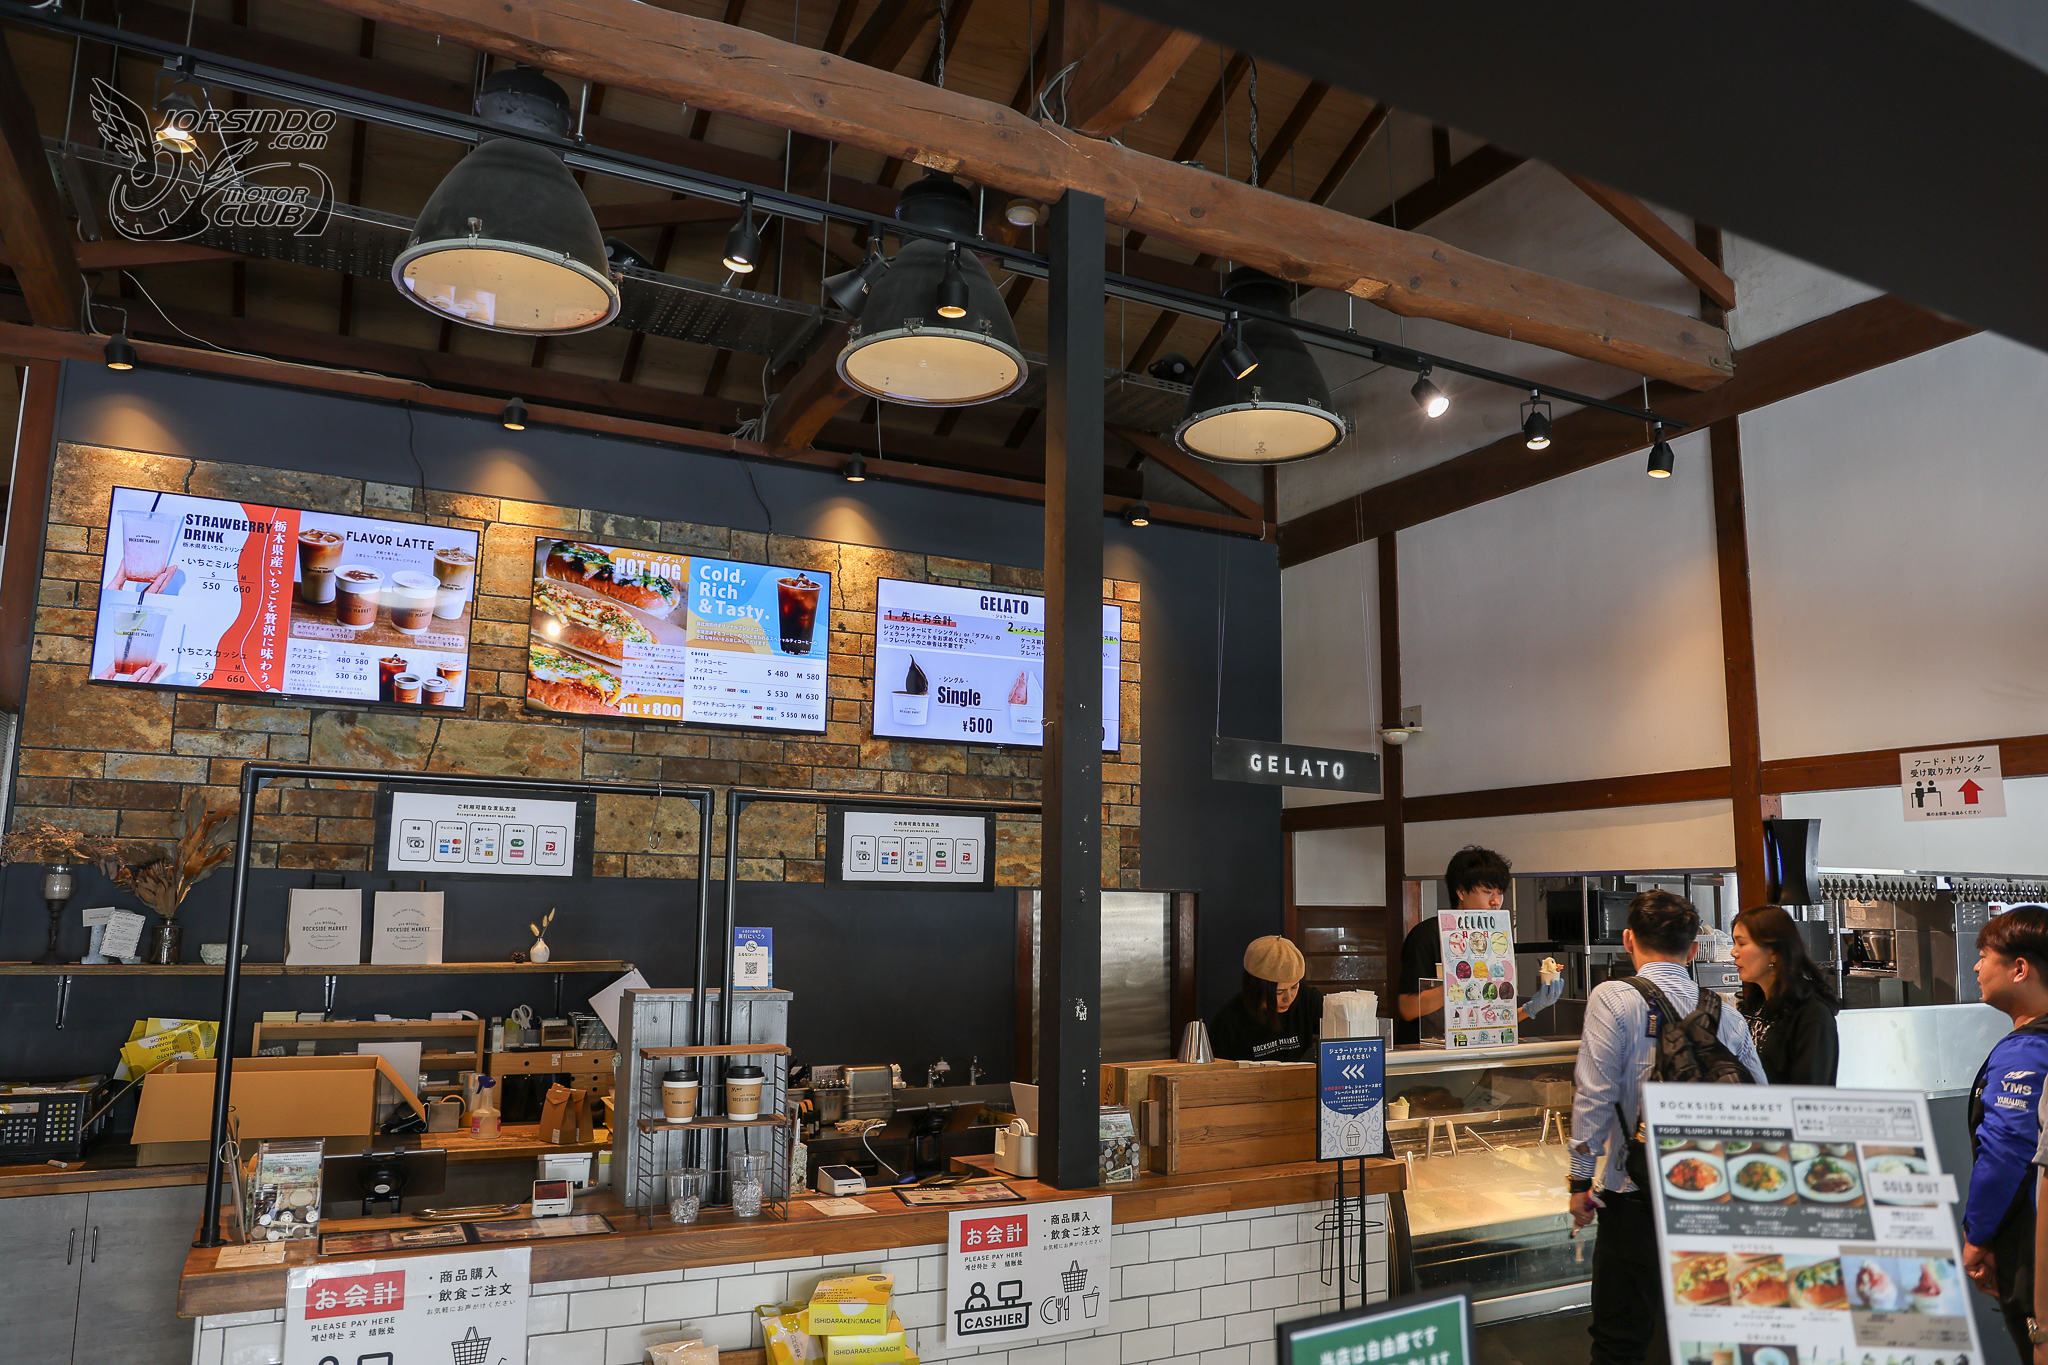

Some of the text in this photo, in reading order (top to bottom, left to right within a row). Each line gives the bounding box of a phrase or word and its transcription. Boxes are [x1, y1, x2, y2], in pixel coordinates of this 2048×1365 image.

[185, 513, 273, 534] STRAWBERRY
[184, 528, 224, 543] DRINK
[346, 531, 435, 551] FLAVOR LATTE
[615, 557, 682, 580] HOT DOG
[700, 565, 747, 587] Cold,
[202, 581, 251, 594] 550 660
[699, 582, 738, 600] Rich
[698, 598, 770, 623] & Tasty.
[980, 595, 1029, 614] GELATO
[901, 611, 953, 626] 先にお会計
[291, 647, 328, 655] ホットコーヒー
[336, 656, 351, 664] 480
[694, 658, 728, 666] ホットコーヒー
[196, 672, 245, 683] 550 660
[335, 672, 350, 680] 530
[693, 667, 728, 675] アイスコーヒー
[767, 669, 772, 677] S
[774, 670, 789, 678] 480
[806, 673, 820, 681] 580
[943, 675, 964, 684] シングル
[774, 690, 789, 698] 530
[805, 693, 820, 701] 630
[937, 685, 981, 708] Single
[619, 702, 682, 718] ALL ¥800
[962, 717, 993, 734] ¥500
[1250, 753, 1345, 780] GELATO
[1914, 754, 1985, 767] フード・ドリンク
[1910, 764, 1992, 778] 受け取りカウンター
[457, 803, 517, 813] ご利用可能な支払方法
[1458, 915, 1495, 930] GELATO
[1252, 1036, 1299, 1053] ROCKSIDE MARKET
[1329, 1046, 1378, 1055] ジェラートチケットを
[2001, 1080, 2032, 1096] YMS
[1660, 1101, 1783, 1113] ROCKSIDE MARKET
[1658, 1126, 1680, 1135] FOOD
[1715, 1128, 1733, 1137] TIME
[1882, 1180, 1940, 1195] SOLD OUT
[966, 1222, 1023, 1246] お会計
[964, 1254, 990, 1263] PLEASE
[1006, 1251, 1023, 1259] HERE
[315, 1281, 398, 1311] お会計
[427, 1299, 516, 1316] お気軽にお声がけください
[311, 1317, 396, 1332] PLEASE PAY HERE
[964, 1311, 1023, 1330] CASHIER
[311, 1331, 345, 1343] 계산하는
